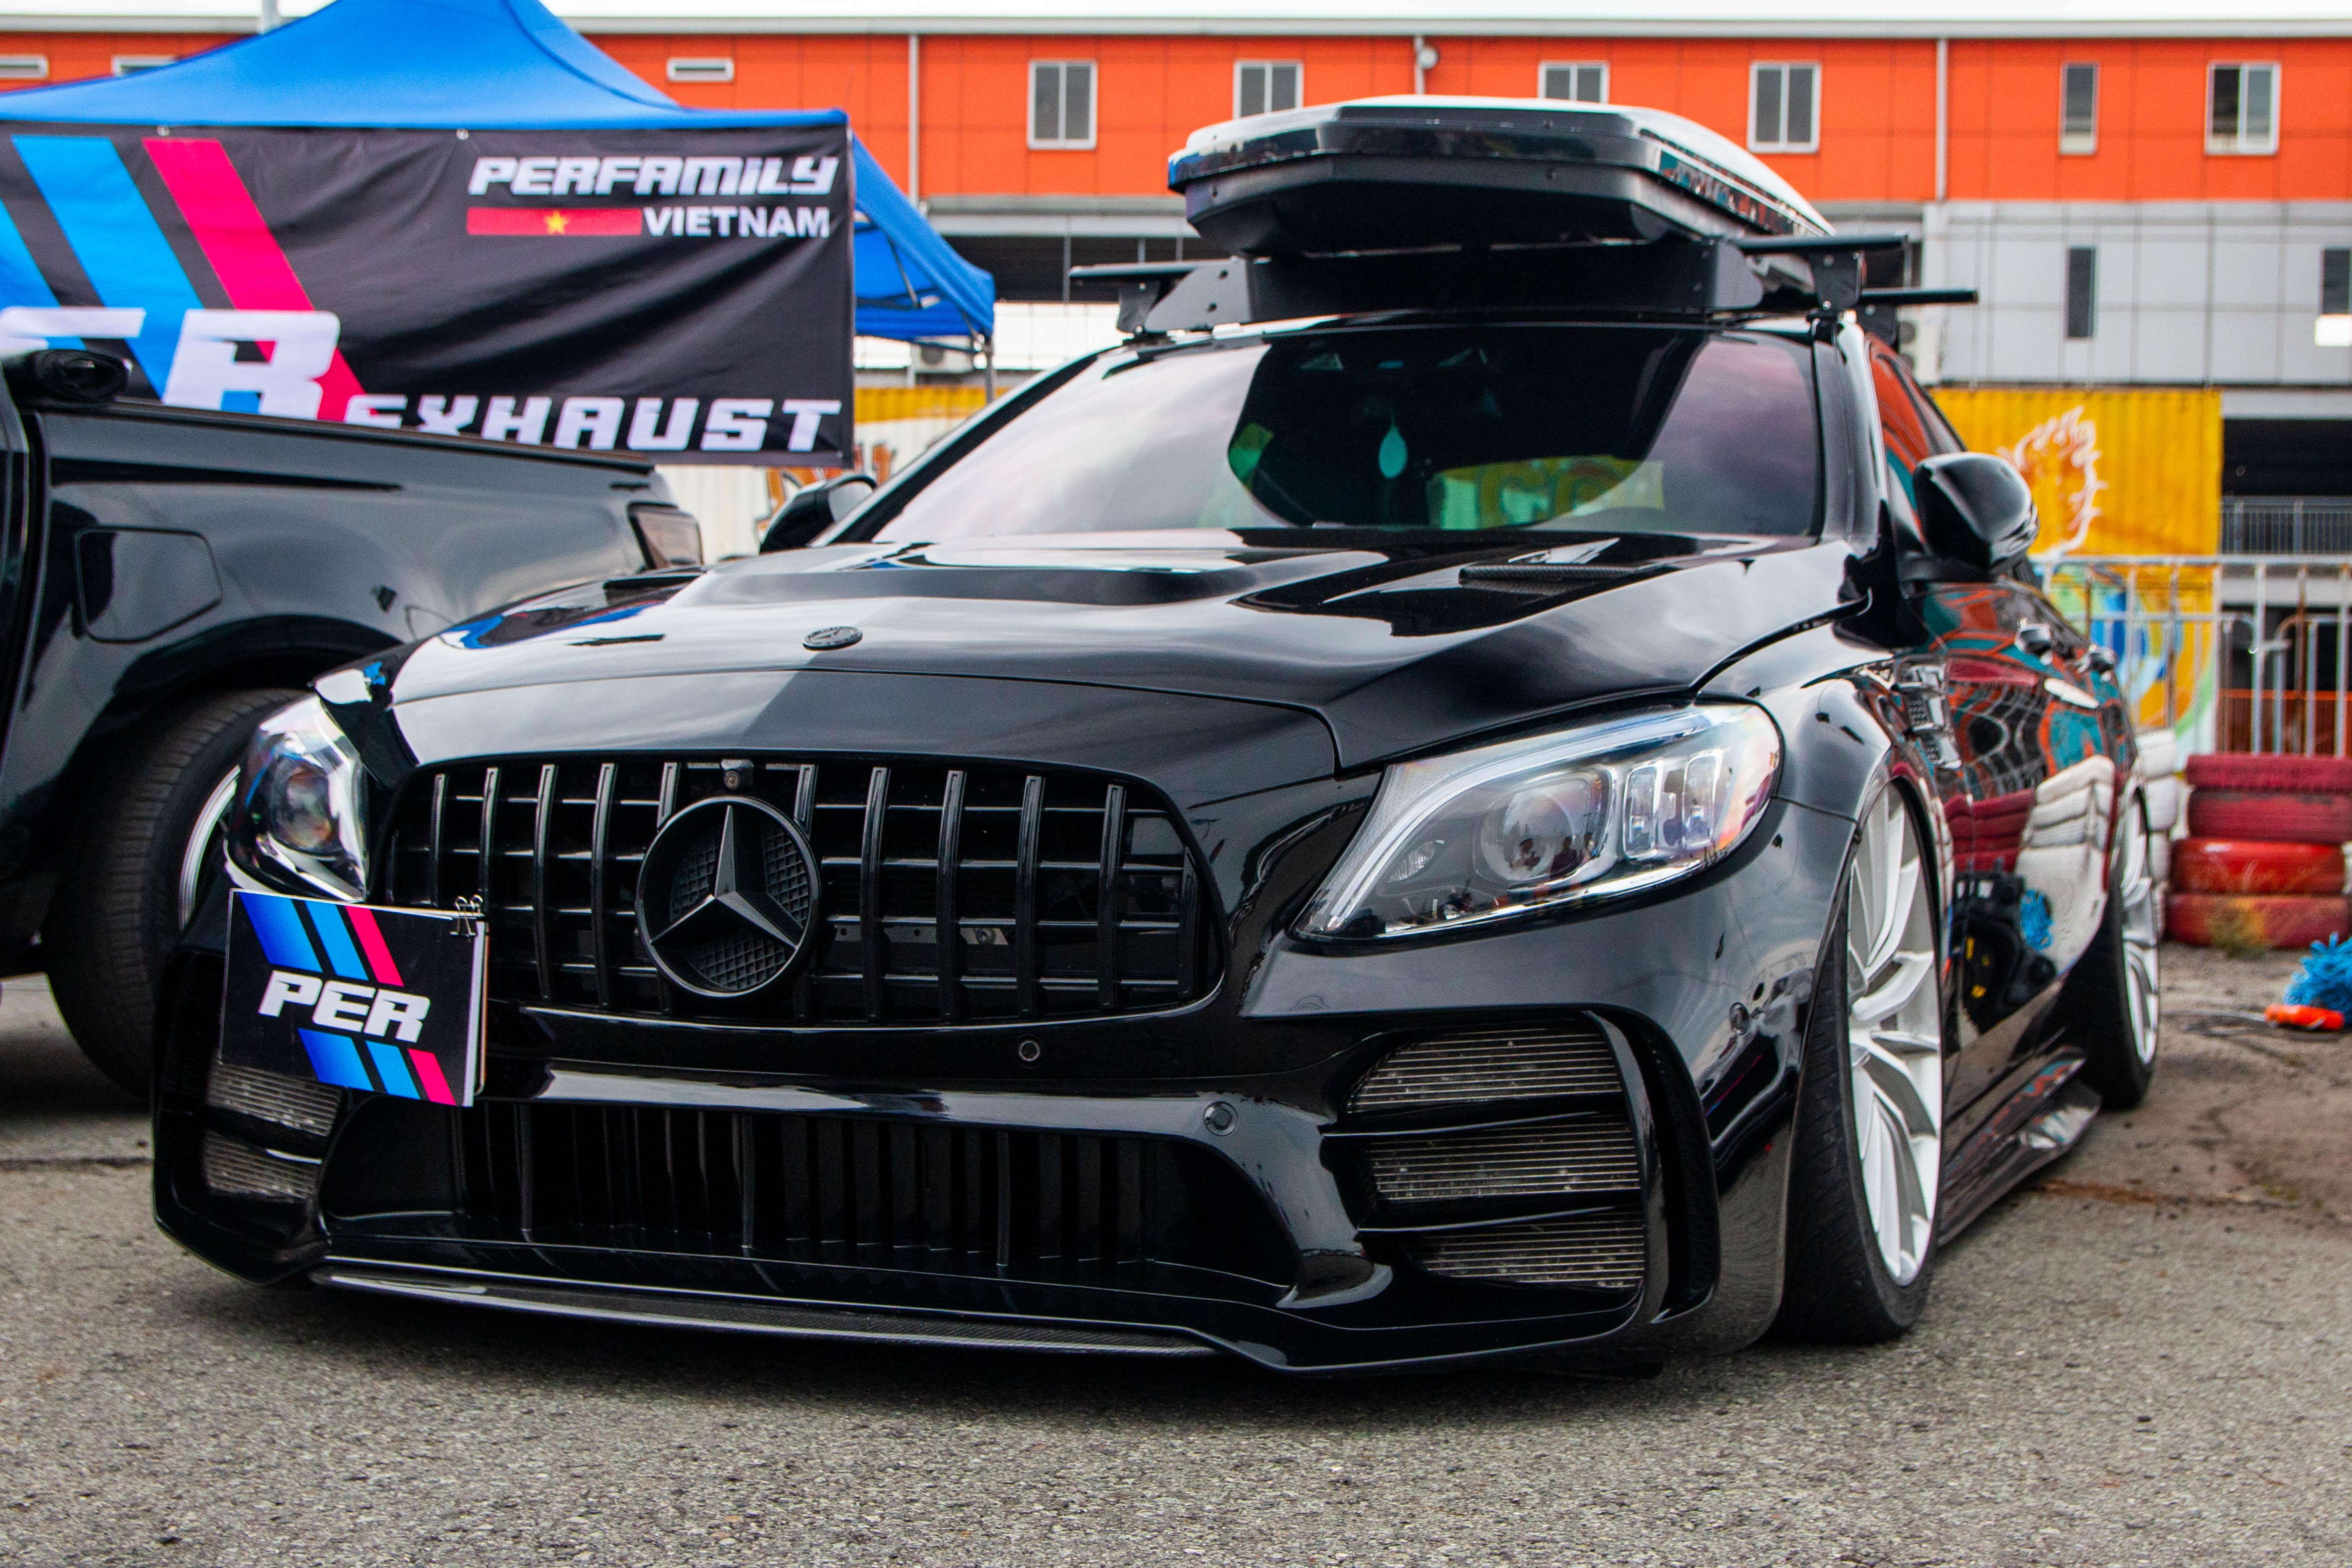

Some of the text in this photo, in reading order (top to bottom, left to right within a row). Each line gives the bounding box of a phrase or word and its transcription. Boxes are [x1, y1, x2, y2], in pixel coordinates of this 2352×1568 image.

[468, 156, 839, 195] PERFAMILY
[643, 206, 830, 238] VIETNAM
[344, 394, 842, 452] EXHAUST
[258, 969, 431, 1043] PER
